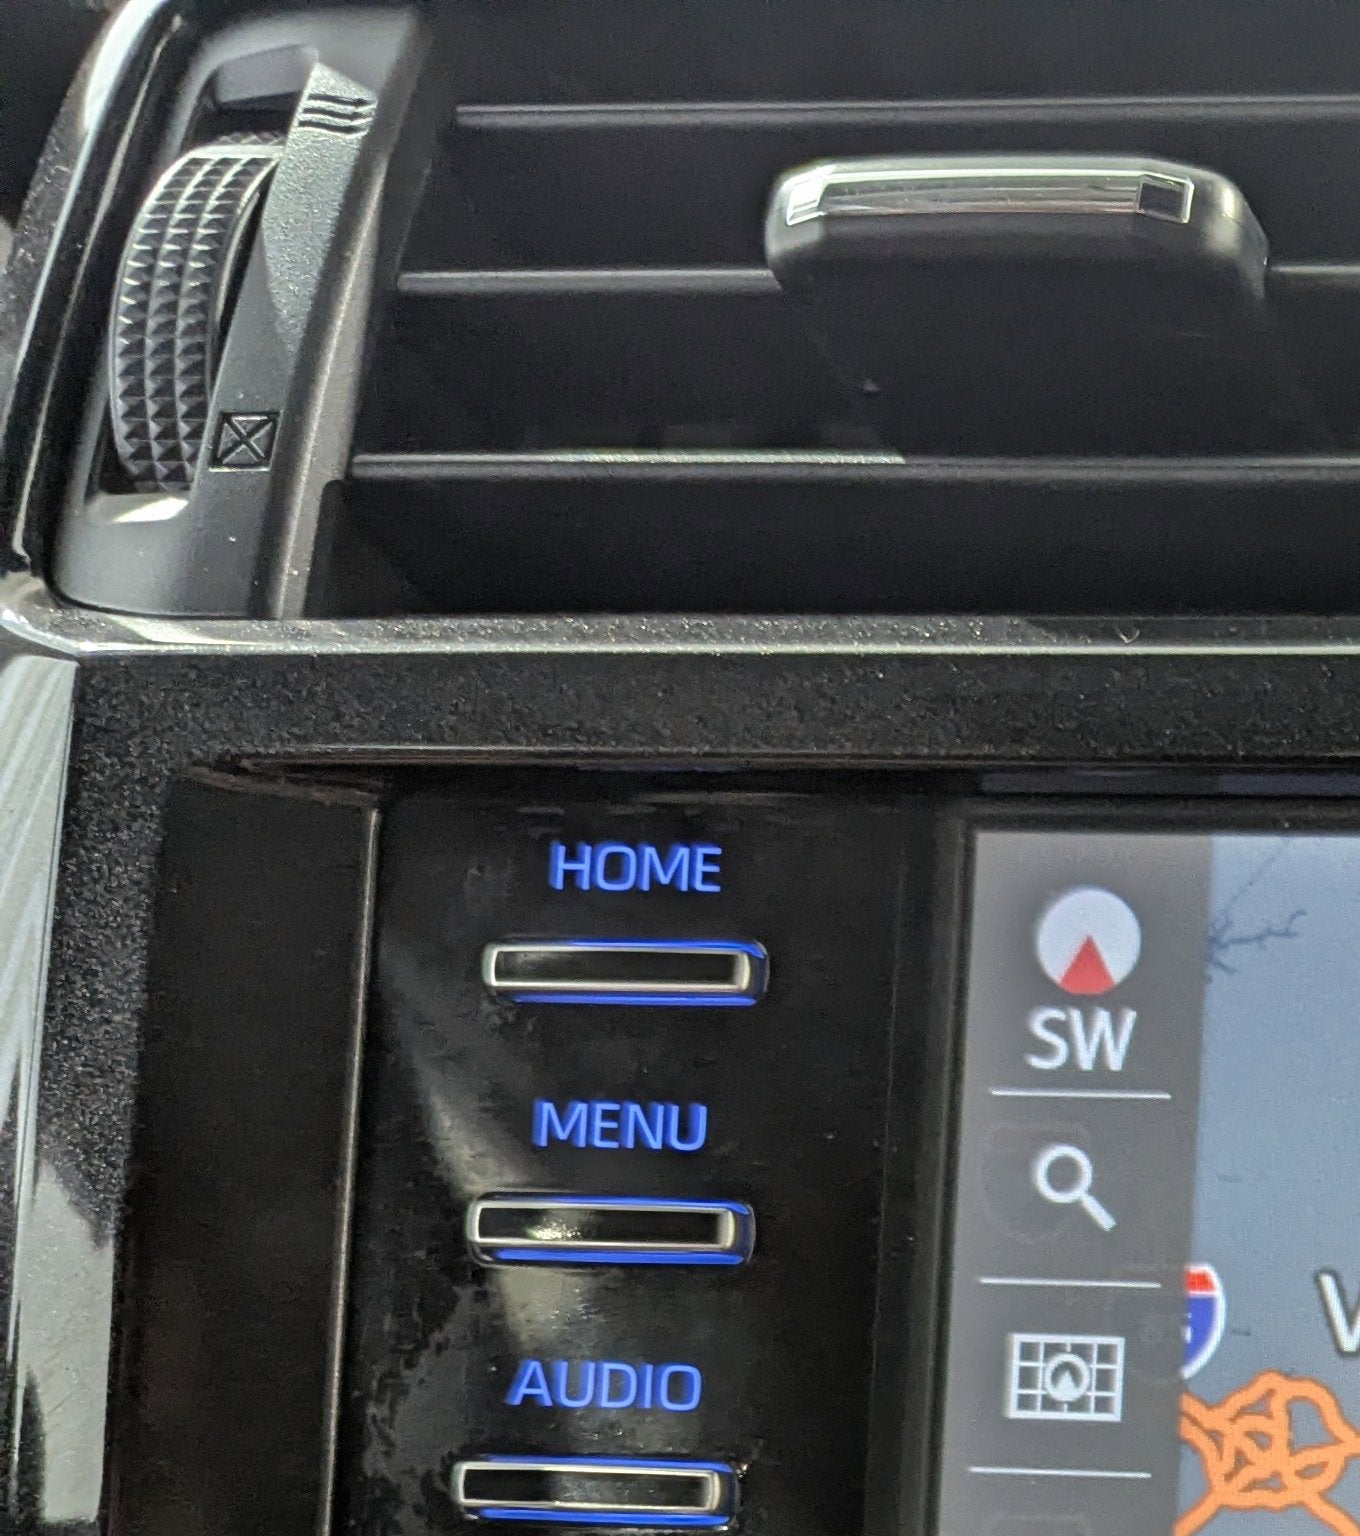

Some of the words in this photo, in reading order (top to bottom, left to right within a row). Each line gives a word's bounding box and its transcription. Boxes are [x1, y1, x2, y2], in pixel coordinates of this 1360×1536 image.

[549, 841, 723, 893] HOME
[1024, 1006, 1137, 1072] SW
[532, 1100, 709, 1152] MENU
[506, 1358, 703, 1412] AUDIO
